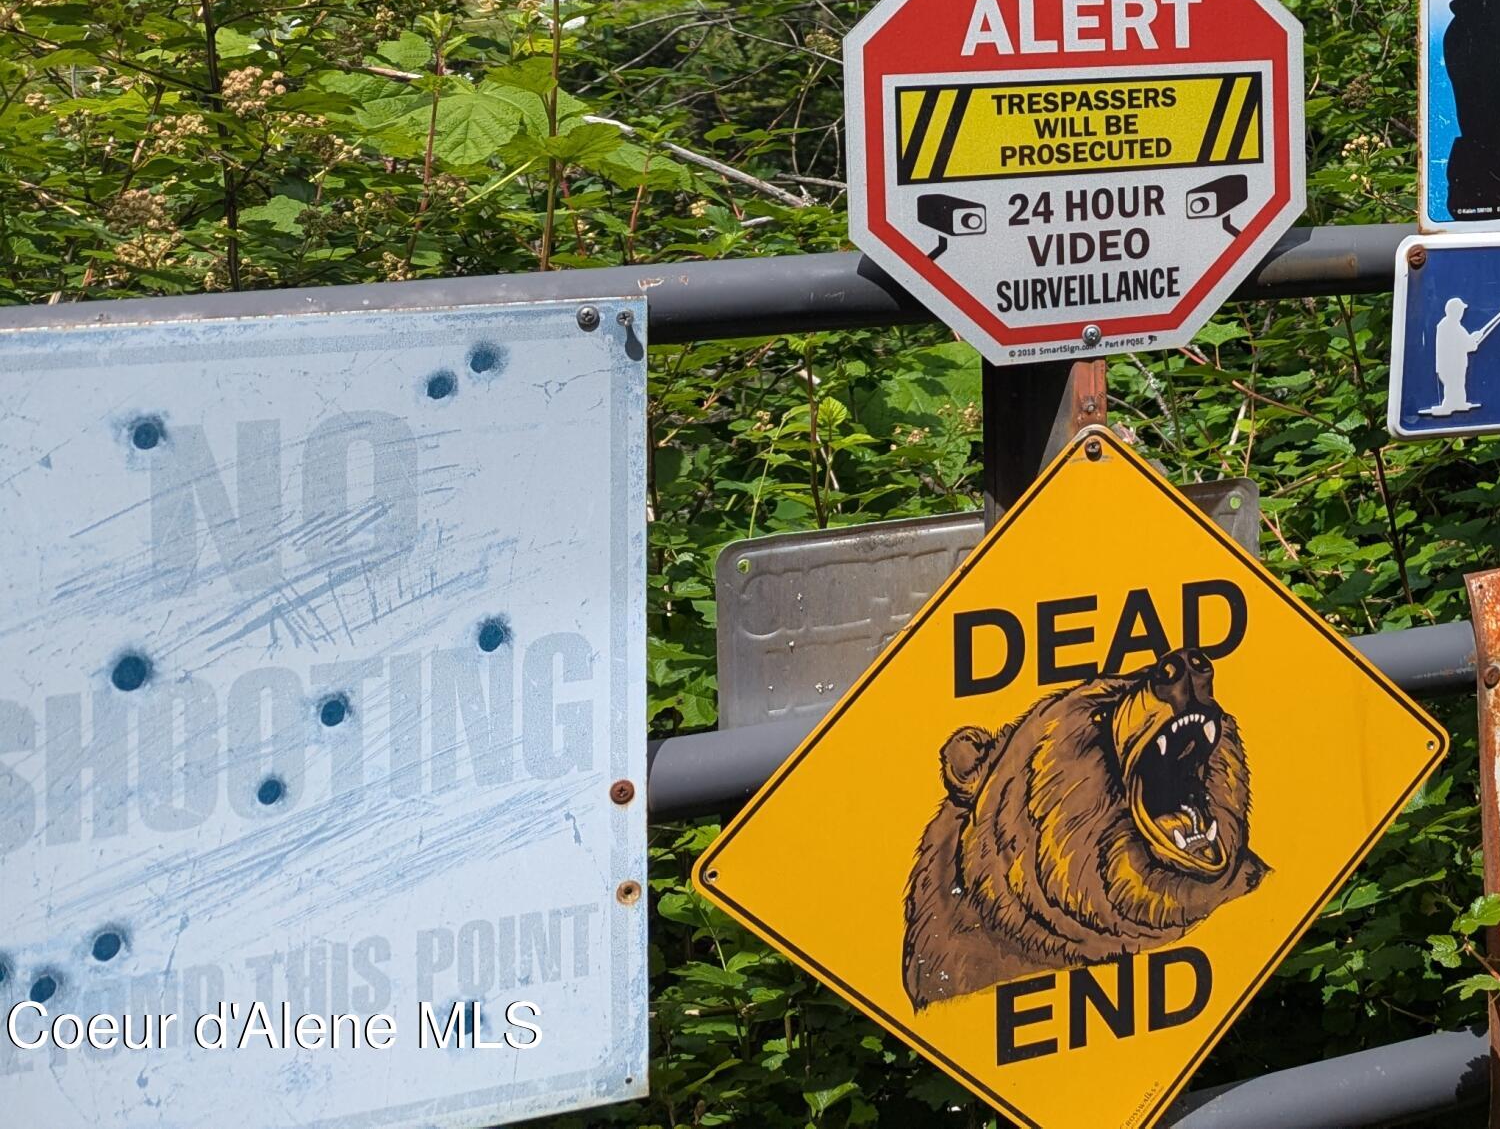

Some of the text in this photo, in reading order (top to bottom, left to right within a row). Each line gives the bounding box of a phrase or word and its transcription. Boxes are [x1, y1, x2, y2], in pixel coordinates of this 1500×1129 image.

[991, 87, 1177, 116] TRESPASSERS
[1034, 114, 1139, 139] WILL BE
[1000, 138, 1173, 167] PROSECUTED
[1008, 184, 1166, 227] 24 HOUR
[1027, 227, 1151, 267] VIDEO
[996, 266, 1181, 313] SURVEILLANCE
[150, 410, 418, 599] NO
[952, 577, 1249, 699] DEAD
[417, 902, 599, 1006] POINT
[995, 944, 1213, 1067] END
